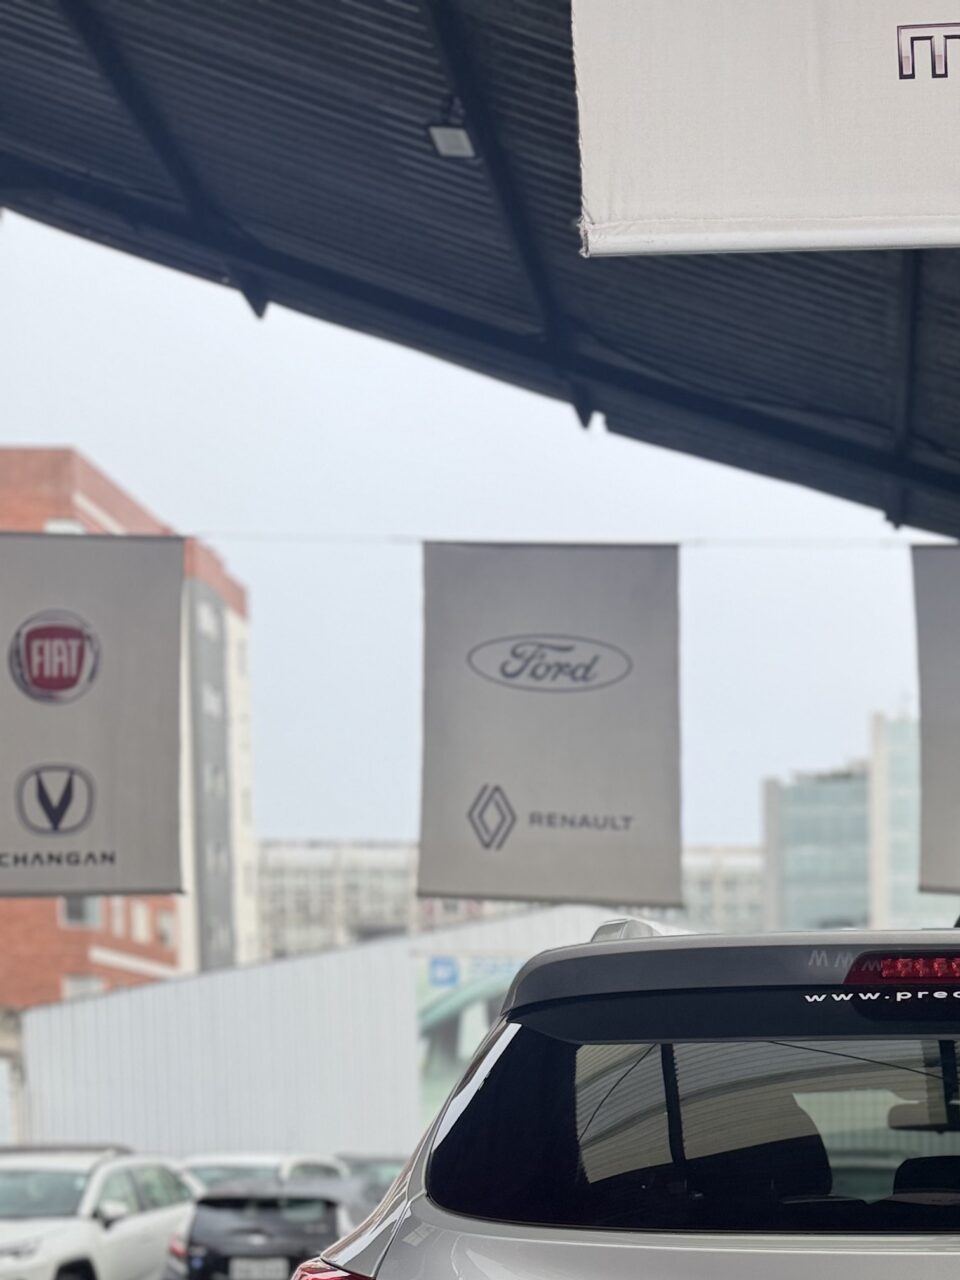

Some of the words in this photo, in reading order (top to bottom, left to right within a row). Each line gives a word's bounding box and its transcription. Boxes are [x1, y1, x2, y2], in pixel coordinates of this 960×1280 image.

[31, 638, 82, 679] FIAT
[499, 640, 600, 682] Ford
[528, 811, 635, 831] RENAULT
[0, 850, 116, 868] CHANGAN
